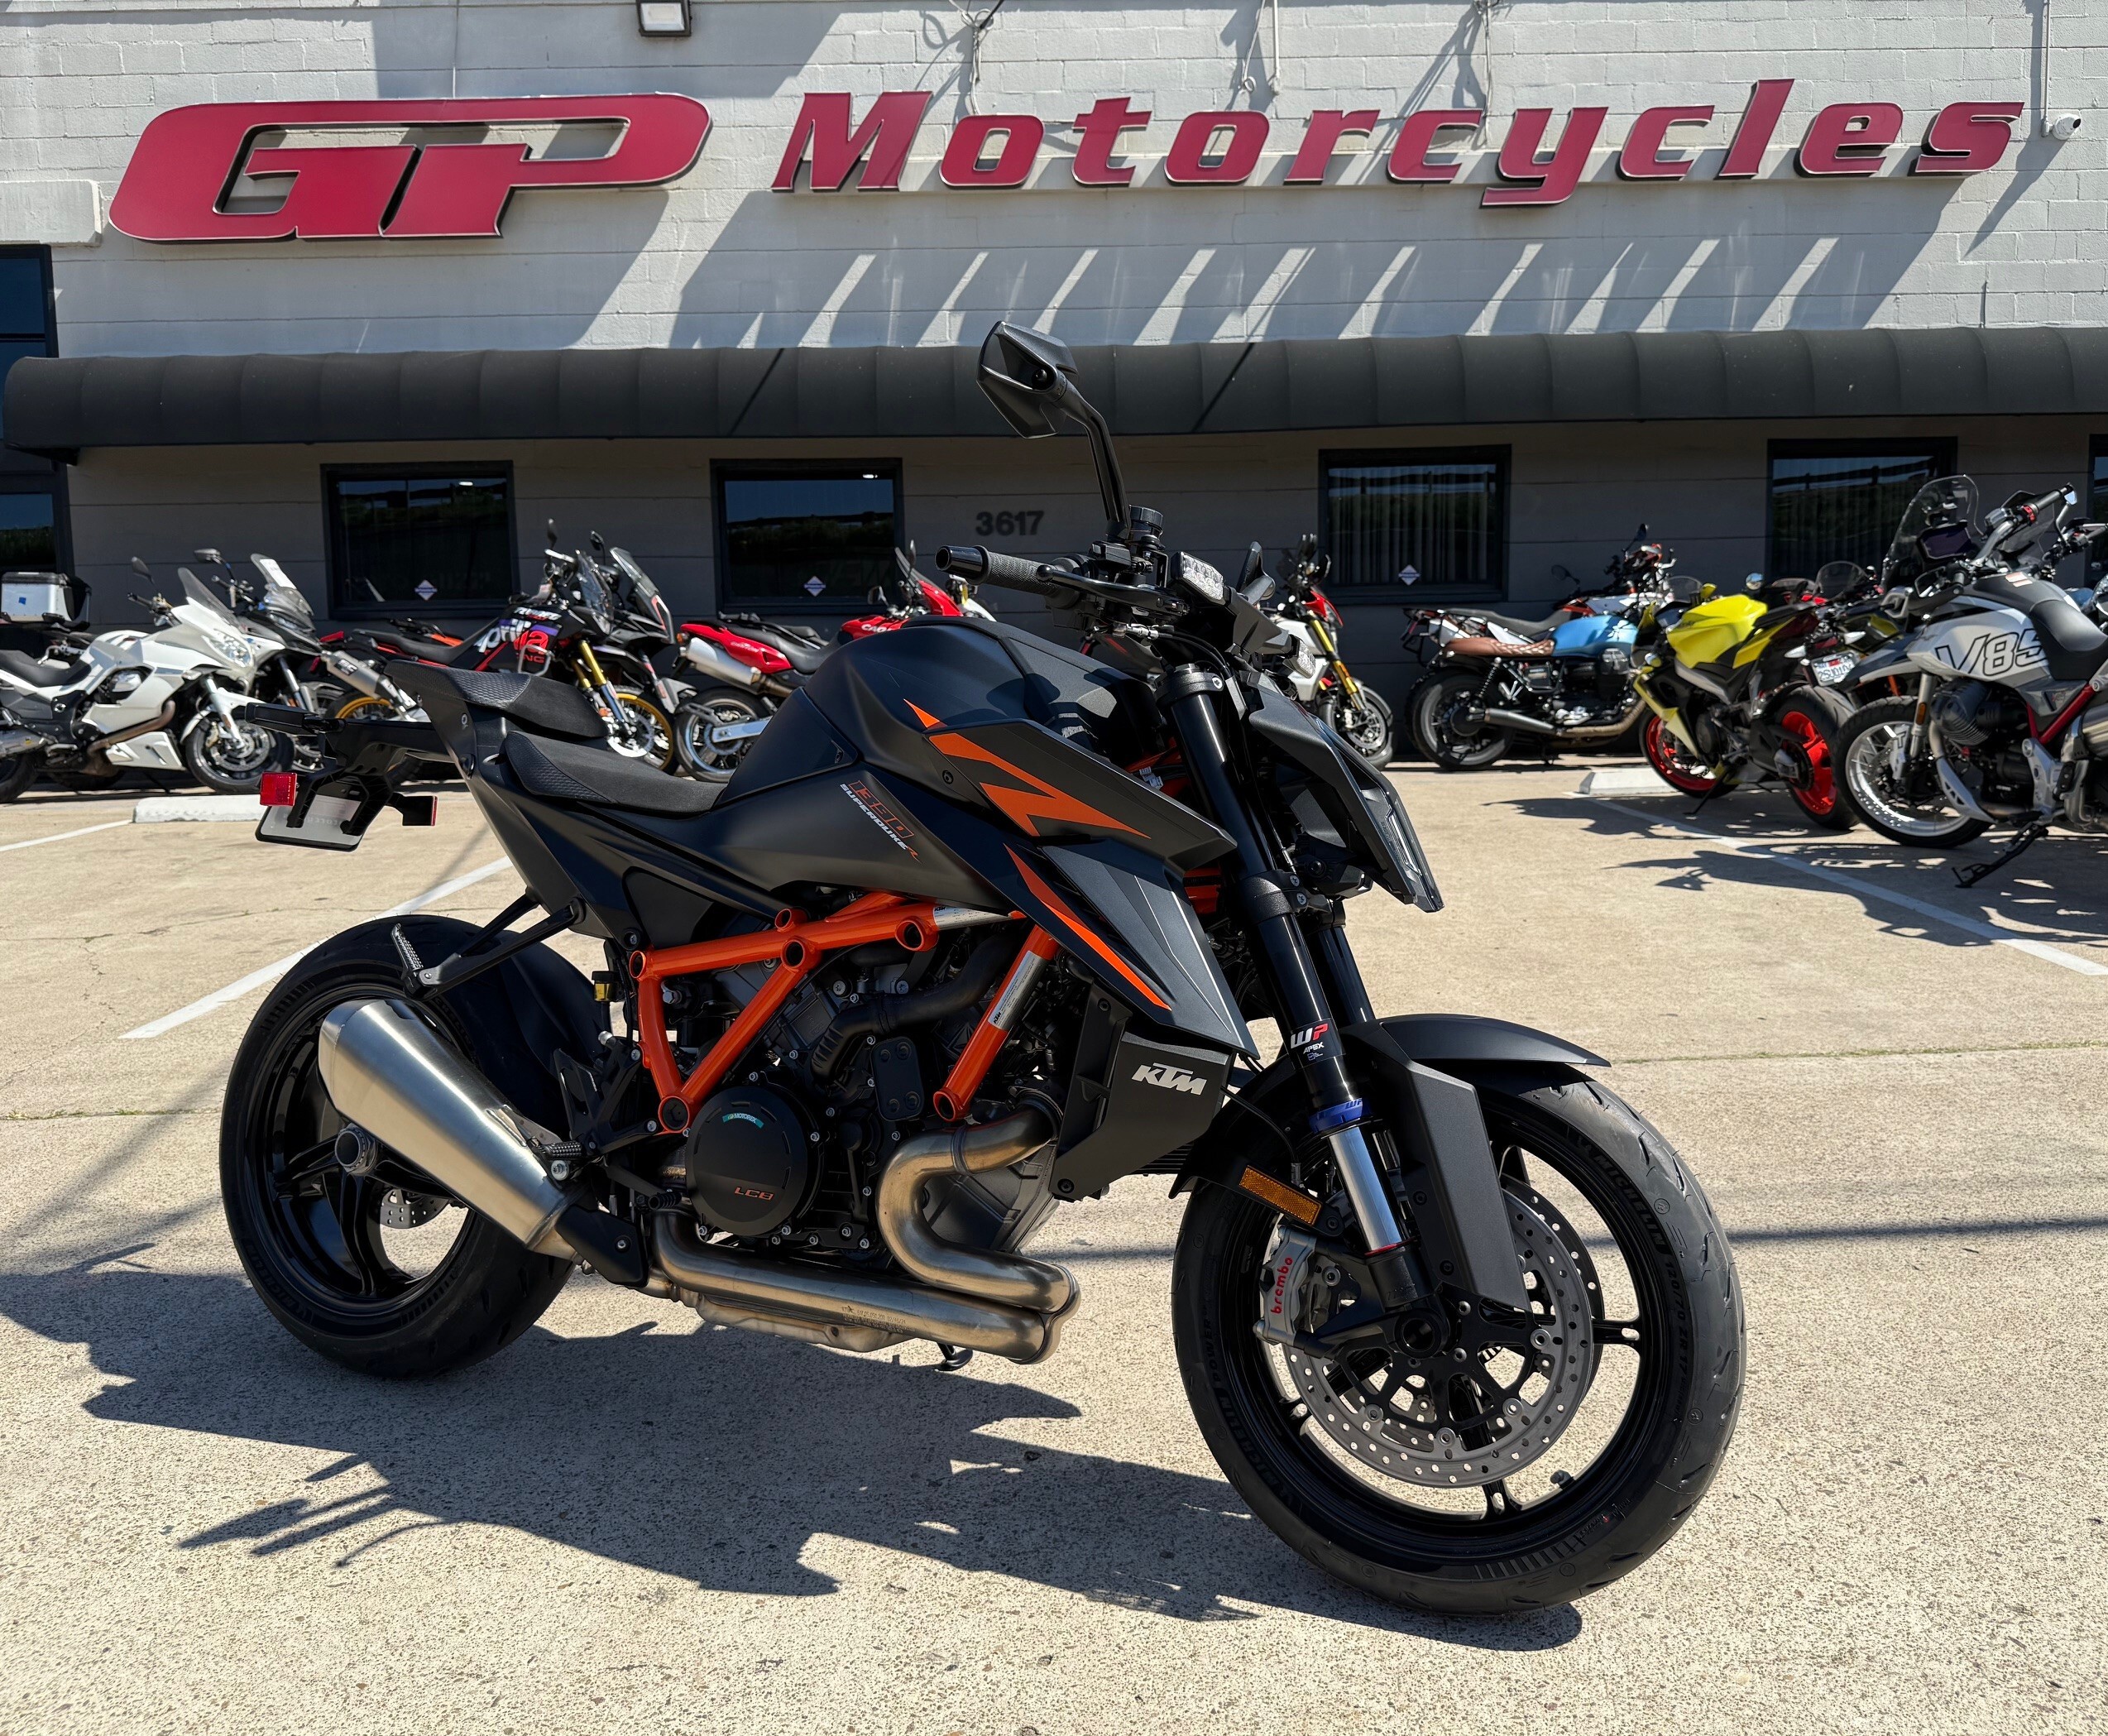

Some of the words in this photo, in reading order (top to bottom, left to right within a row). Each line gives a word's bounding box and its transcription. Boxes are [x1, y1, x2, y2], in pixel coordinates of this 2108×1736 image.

[109, 91, 711, 241] GP
[771, 78, 2024, 206] Motorcycles
[975, 510, 1044, 536] 3617
[1291, 1023, 1329, 1049] WP
[1303, 1042, 1325, 1054] APEX
[1131, 1062, 1208, 1096] KTM
[734, 1112, 758, 1125] MOTOREX
[1593, 1154, 1669, 1247] MICHELIN
[1270, 1257, 1294, 1315] brembo
[1665, 1261, 1685, 1321] 120/70
[1219, 1395, 1281, 1489] MICHELIN
